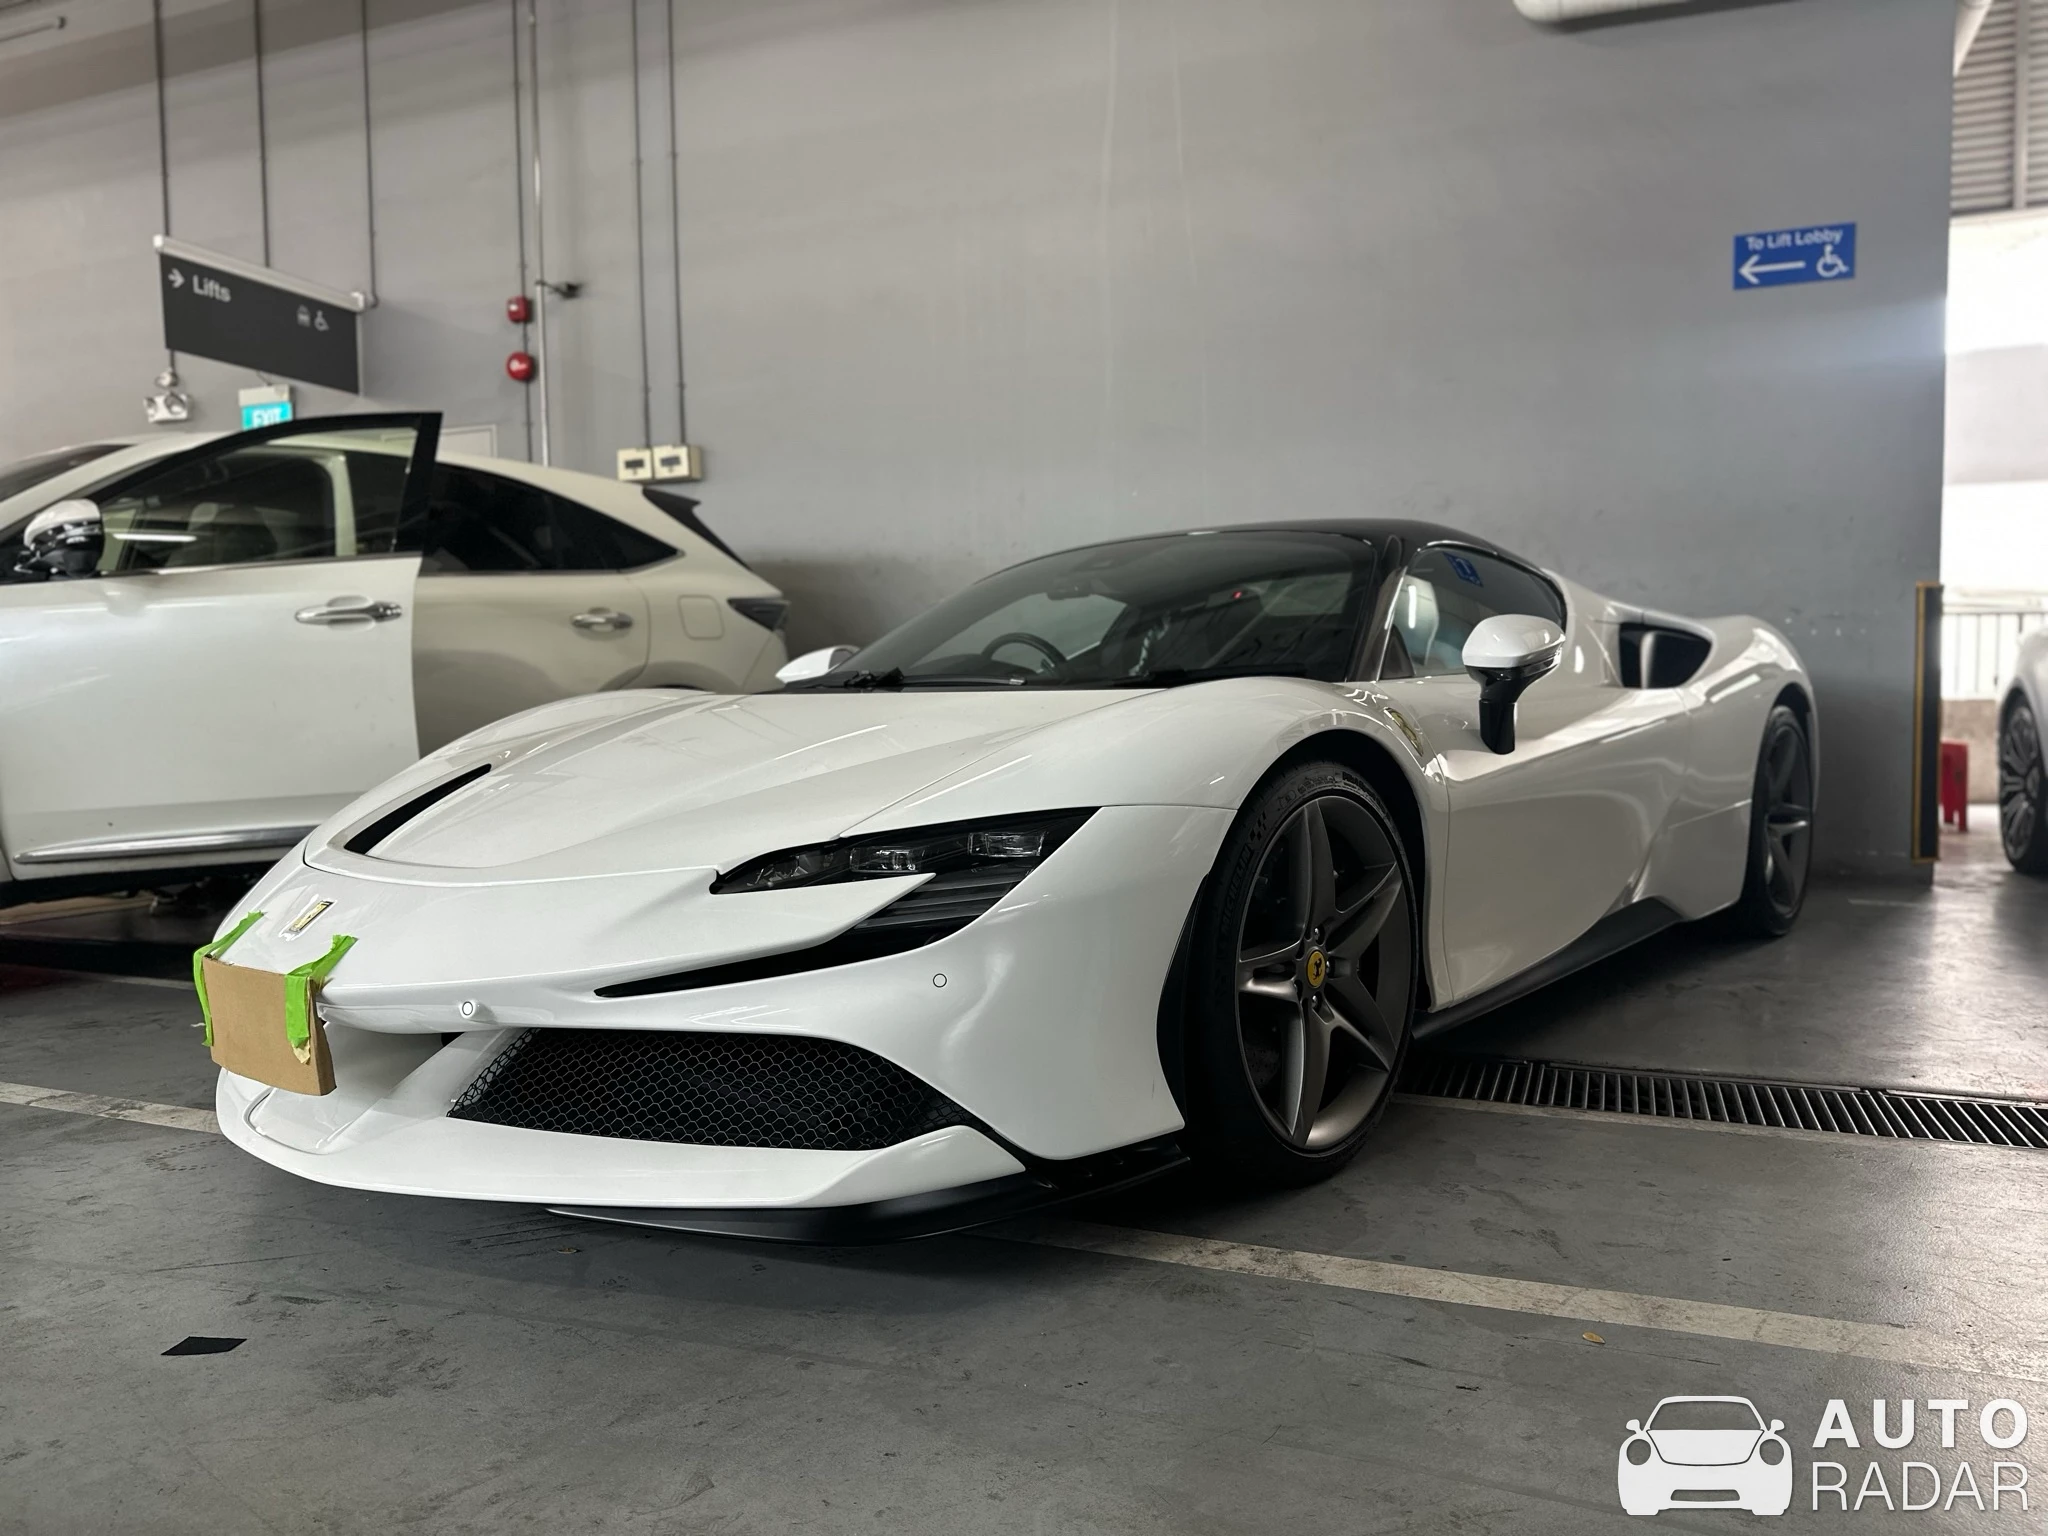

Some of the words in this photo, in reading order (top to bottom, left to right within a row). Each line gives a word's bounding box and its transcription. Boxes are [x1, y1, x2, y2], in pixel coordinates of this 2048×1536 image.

[1746, 236, 1764, 250] To
[1767, 232, 1792, 249] Lift
[1795, 229, 1843, 245] Lobby
[192, 274, 231, 303] Lifts
